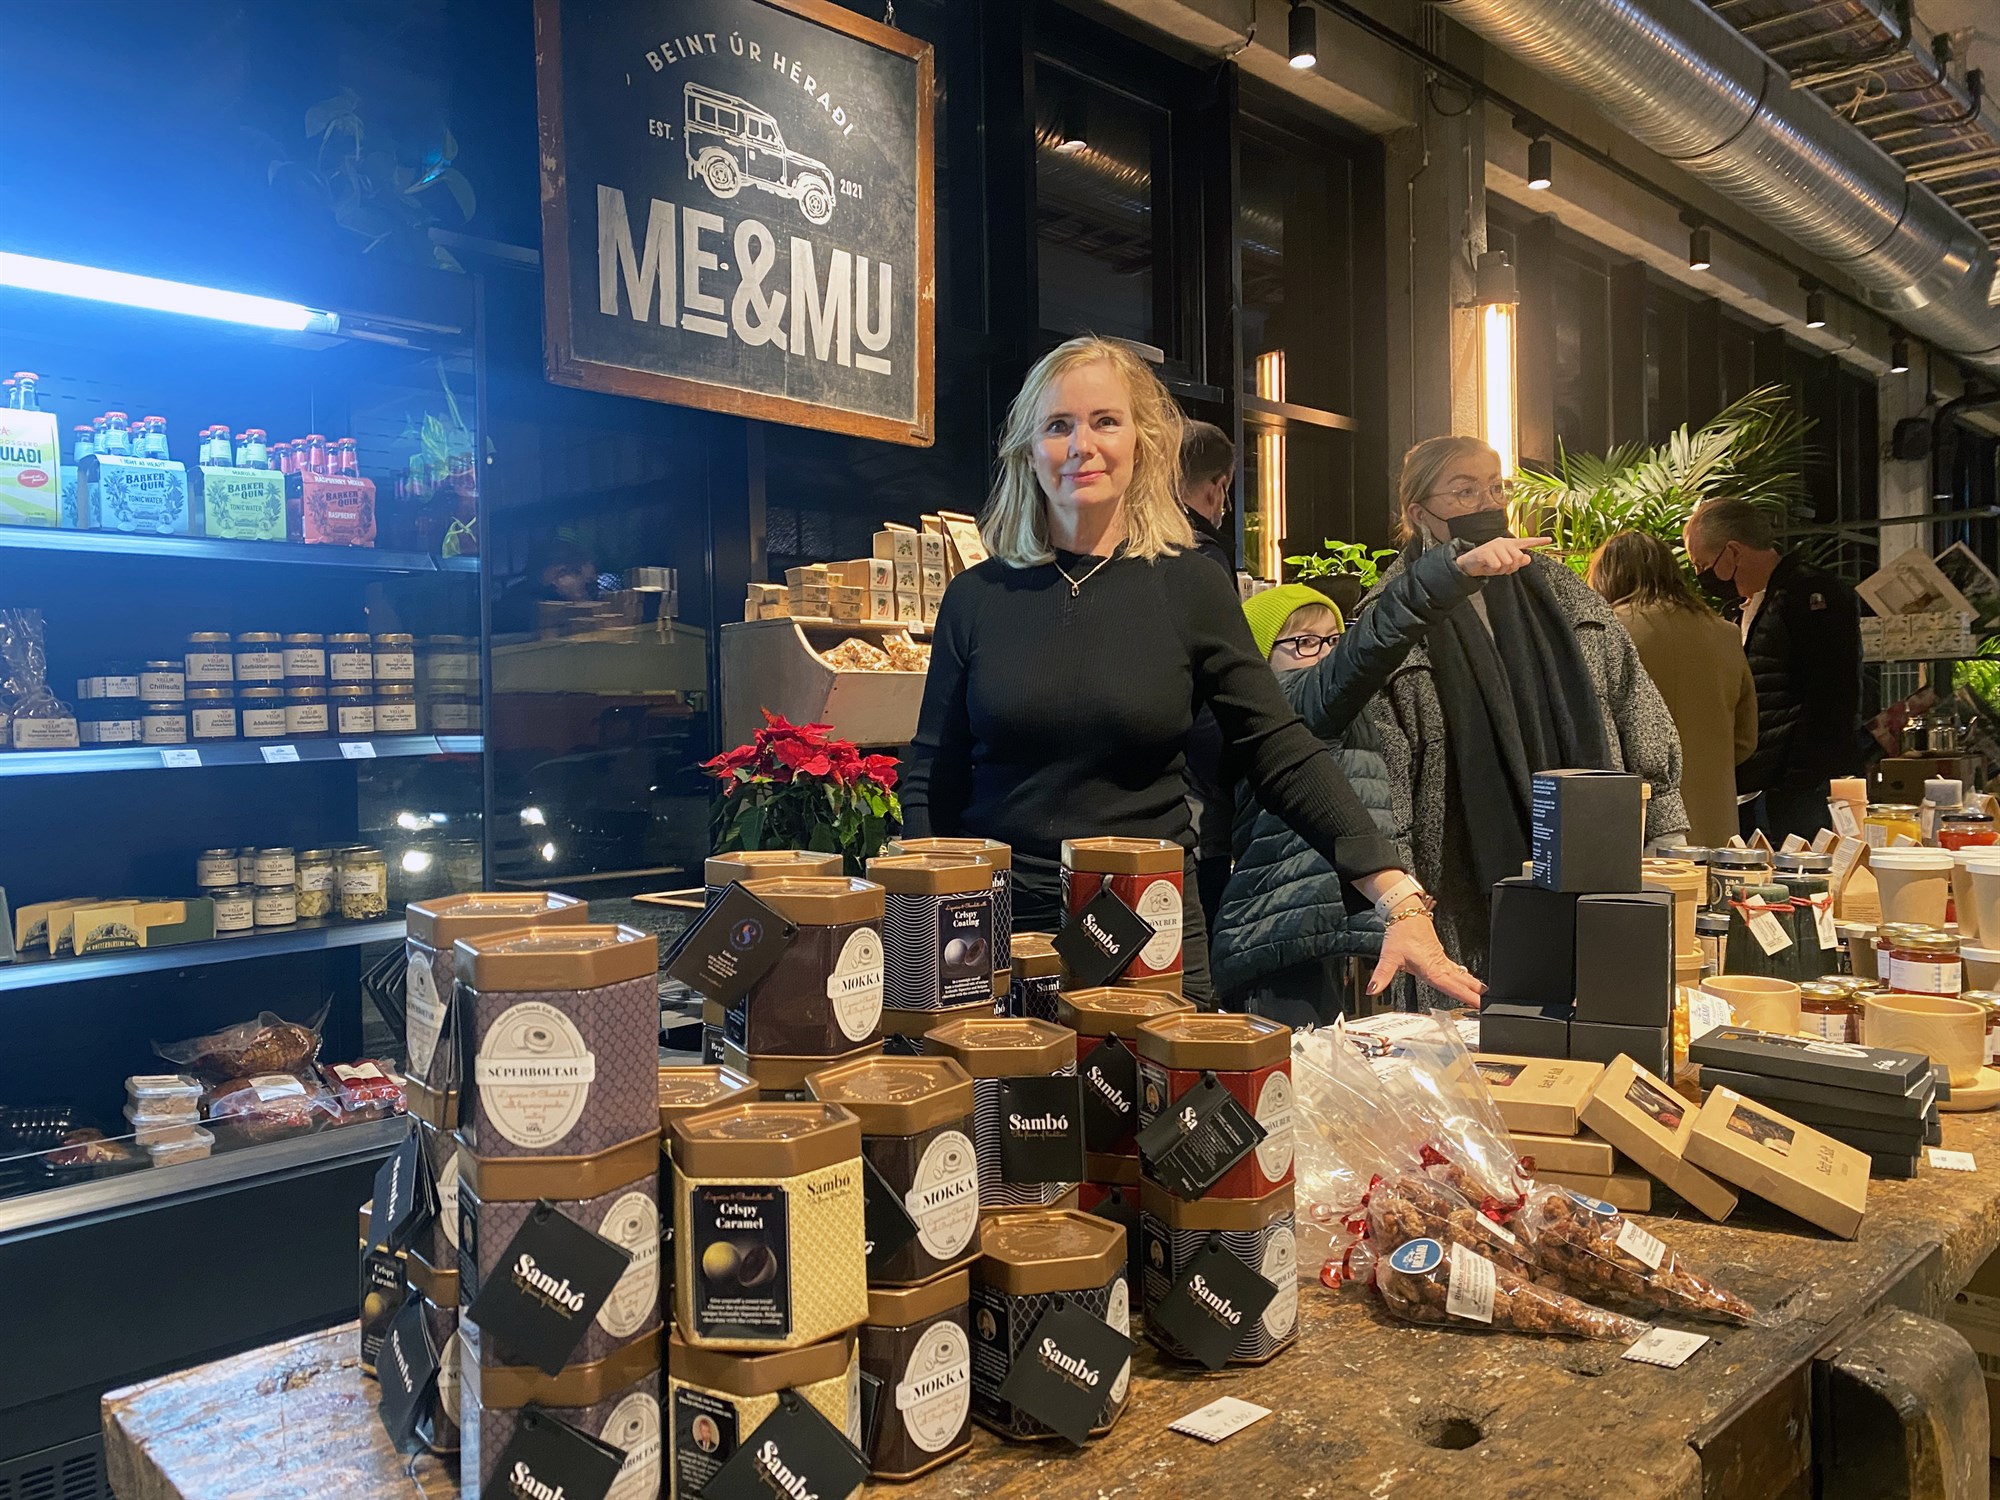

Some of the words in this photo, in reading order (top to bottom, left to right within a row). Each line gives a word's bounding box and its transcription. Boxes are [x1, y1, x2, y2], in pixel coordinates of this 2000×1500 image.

[645, 33, 716, 72] BEINT
[729, 31, 761, 62] ÚR
[772, 51, 854, 137] HÉRAÐI
[648, 119, 674, 141] EST.
[839, 178, 863, 199] 2021
[597, 184, 892, 375] ME&MU
[126, 473, 165, 484] BARKER
[140, 481, 165, 490] QUIN
[227, 482, 264, 493] BARKER
[241, 490, 264, 499] QUIN
[325, 491, 358, 502] BARKER
[337, 498, 359, 507] QUIN
[328, 511, 356, 519] RASPBERRY
[953, 918, 980, 928] Coating
[954, 911, 977, 921] Crispy
[1082, 913, 1121, 955] Sambó
[841, 972, 880, 992] MOKKA
[488, 1066, 579, 1077] SÚPERBOLTAR
[1087, 1065, 1132, 1113] Sambó
[1009, 1113, 1069, 1130] Sambó
[808, 1173, 850, 1195] Sambó
[923, 1178, 973, 1209] MOKKA
[720, 1203, 757, 1218] Crispy
[715, 1217, 764, 1229] Caramel
[374, 1263, 395, 1280] Crispy
[371, 1274, 398, 1290] Caramel
[514, 1253, 585, 1312] Sambó
[1189, 1274, 1242, 1325] Sambó
[391, 1329, 413, 1393] Sambó
[1039, 1338, 1099, 1386] Sambó
[913, 1368, 964, 1401] MOKKA
